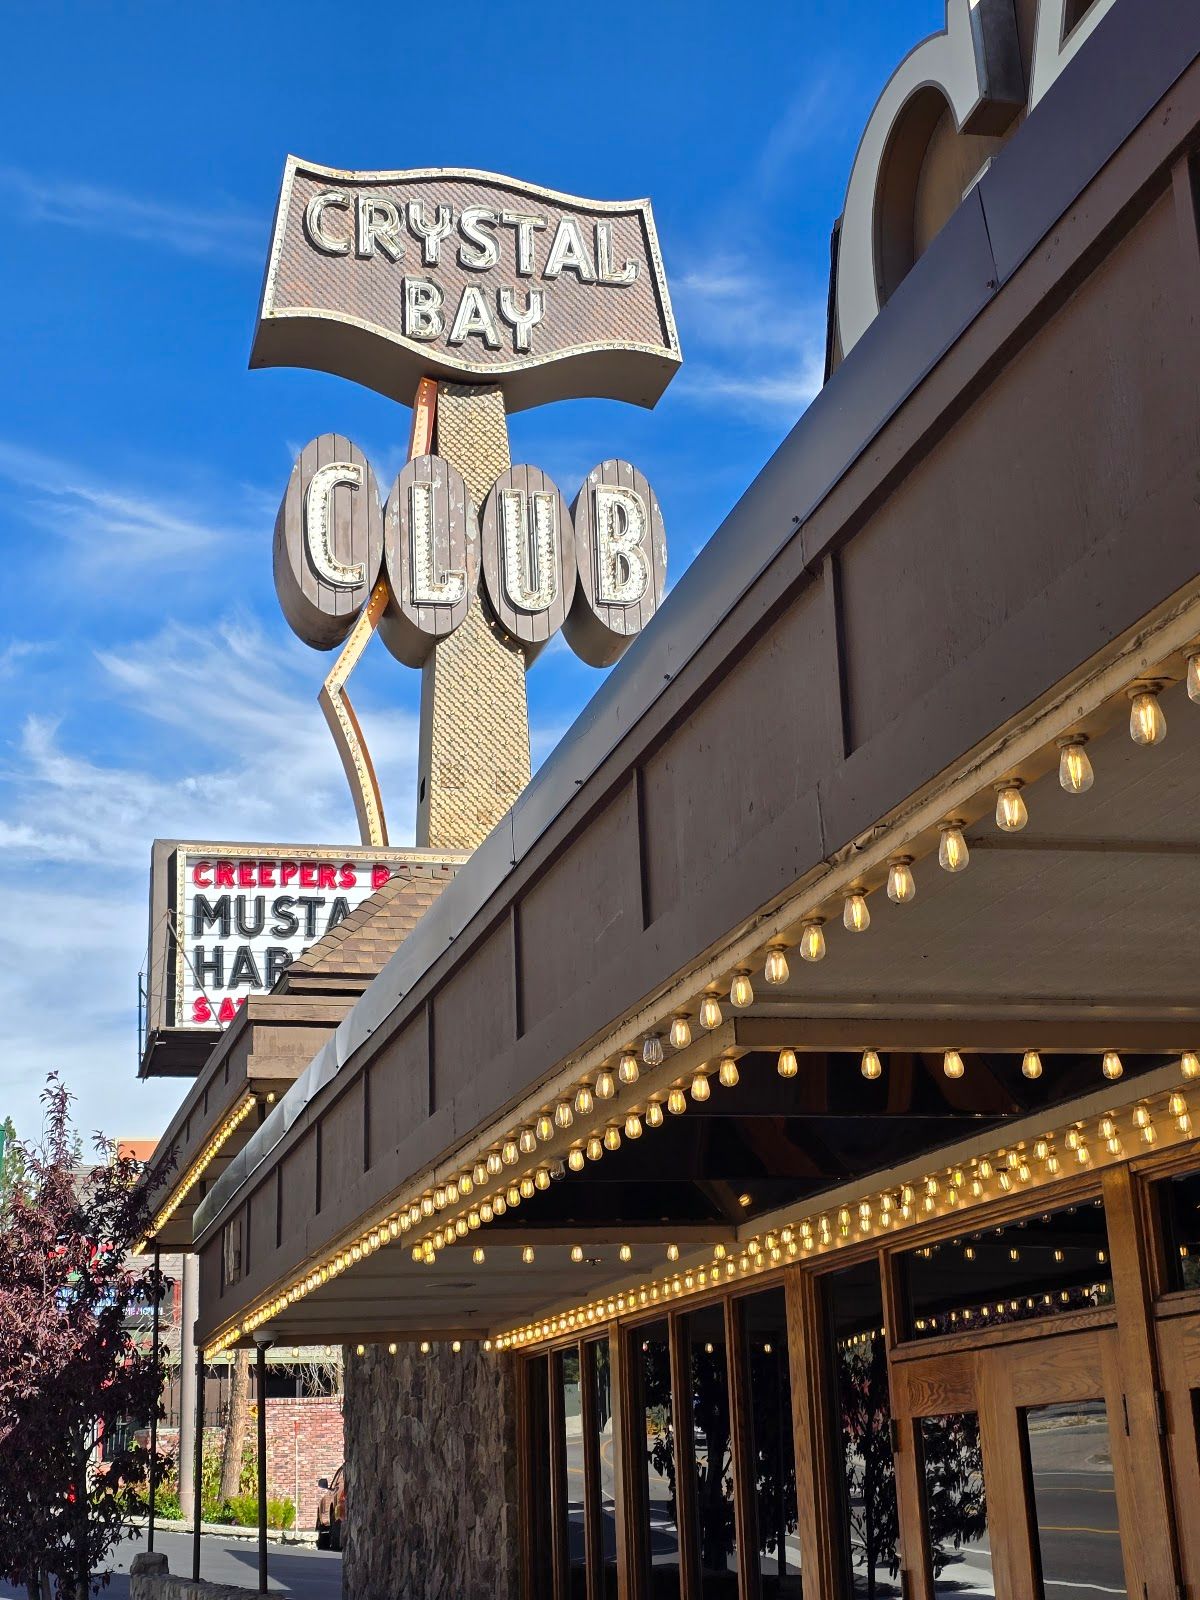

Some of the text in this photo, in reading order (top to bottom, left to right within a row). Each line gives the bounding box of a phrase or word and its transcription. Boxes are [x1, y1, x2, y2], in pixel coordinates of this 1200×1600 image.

[305, 189, 641, 286] CRYSTAL
[403, 275, 545, 353] BAY
[305, 461, 650, 611] CLUB
[191, 860, 356, 890] CREEPERS
[192, 944, 307, 990] HAR
